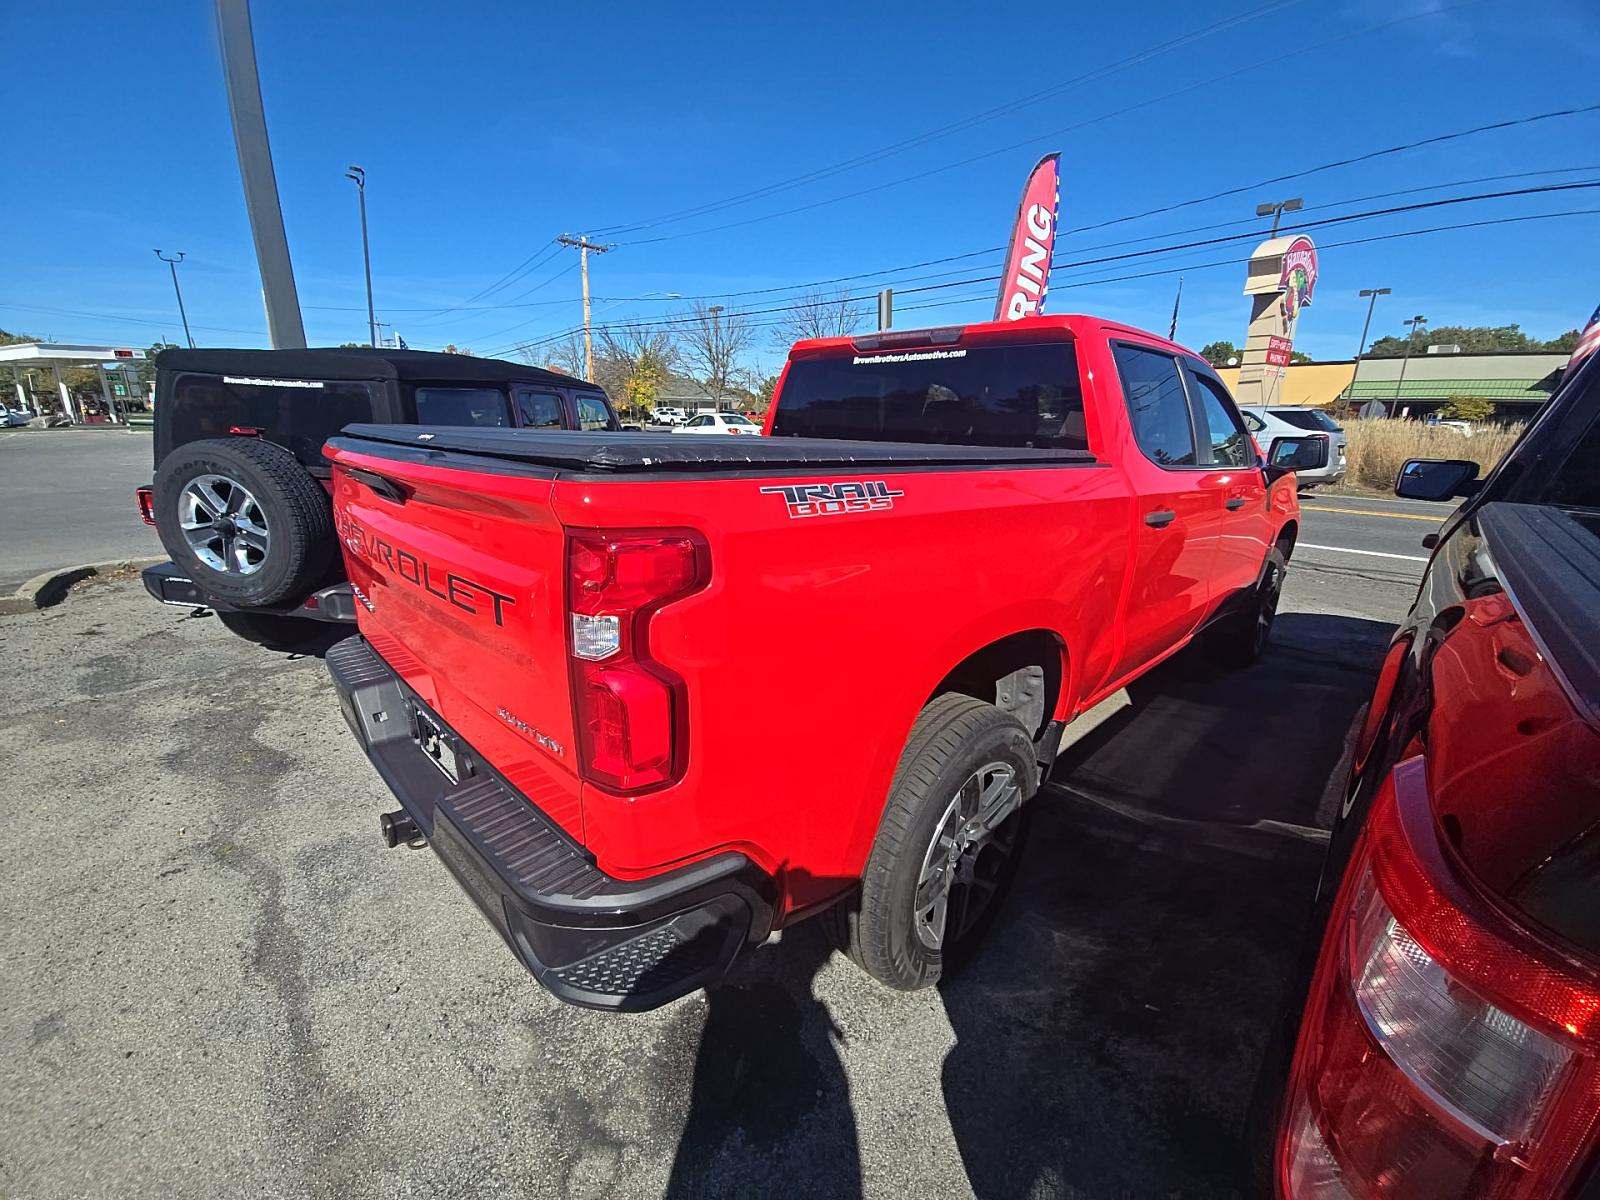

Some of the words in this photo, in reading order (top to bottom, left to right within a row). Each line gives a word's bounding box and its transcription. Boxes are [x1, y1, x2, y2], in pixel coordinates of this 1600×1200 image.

[853, 350, 966, 364] BrownBrothersAutomotive.com
[760, 481, 904, 503] TRAIL
[788, 496, 893, 519] BOSS
[334, 503, 516, 628] CHEVROLET
